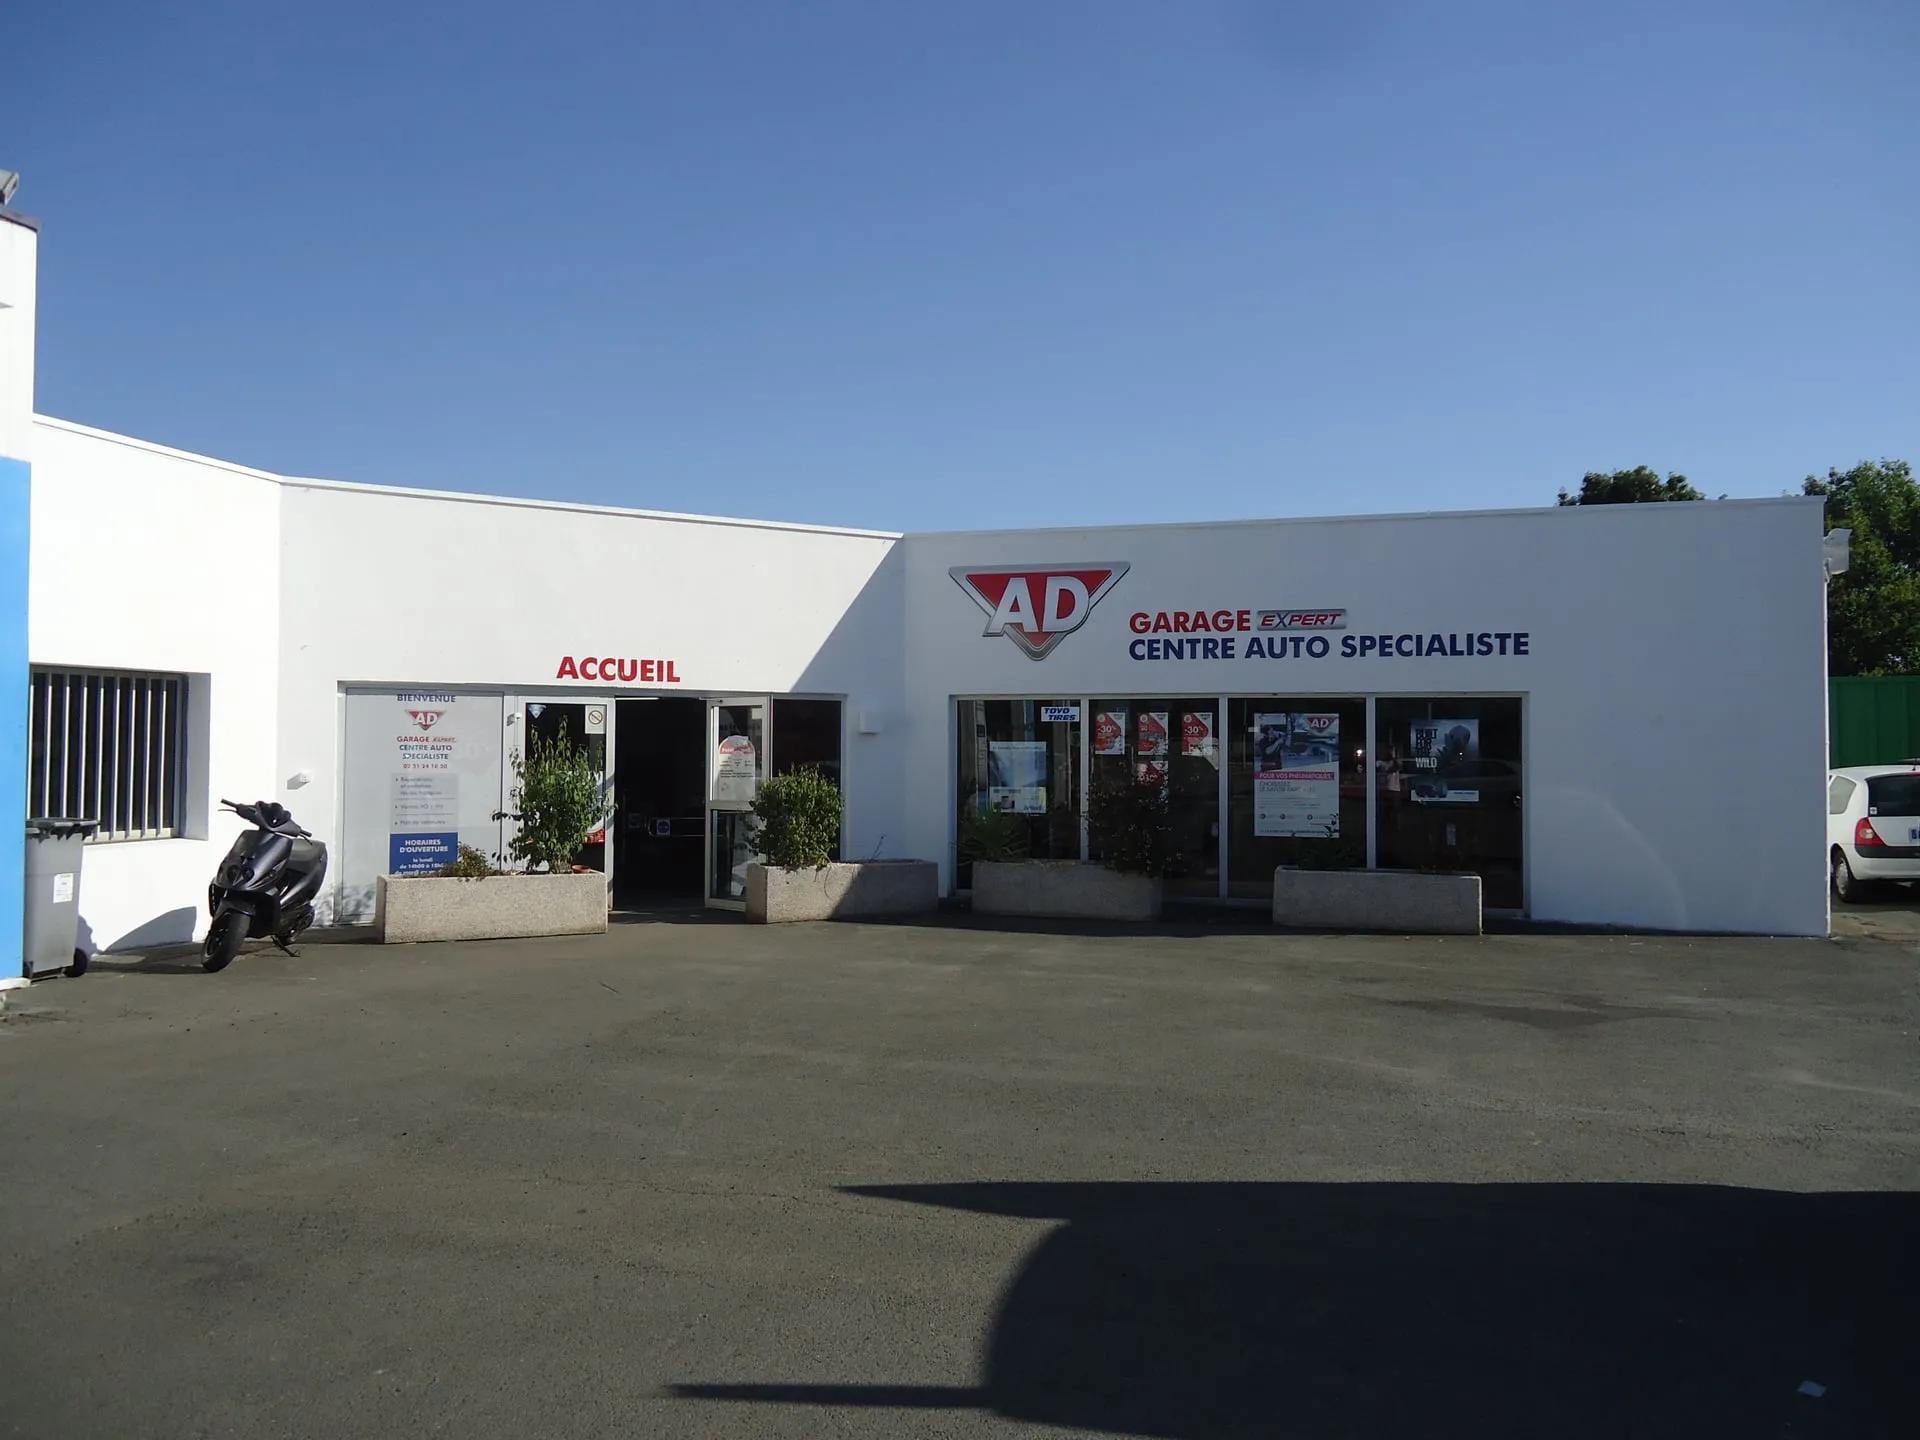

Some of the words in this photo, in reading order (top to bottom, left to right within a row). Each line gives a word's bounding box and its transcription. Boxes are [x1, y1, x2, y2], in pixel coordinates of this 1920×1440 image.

[985, 574, 1091, 636] AD
[1129, 609, 1251, 633] GARAGE
[1128, 637, 1236, 661] CENTRE
[1245, 634, 1330, 659] AUTO
[1340, 632, 1530, 658] SPECIALISTE
[556, 656, 681, 683] ACCUEIL
[397, 694, 457, 703] BIENVENUE
[415, 712, 439, 726] AD
[1309, 717, 1330, 729] AD
[1415, 757, 1438, 768] WILD
